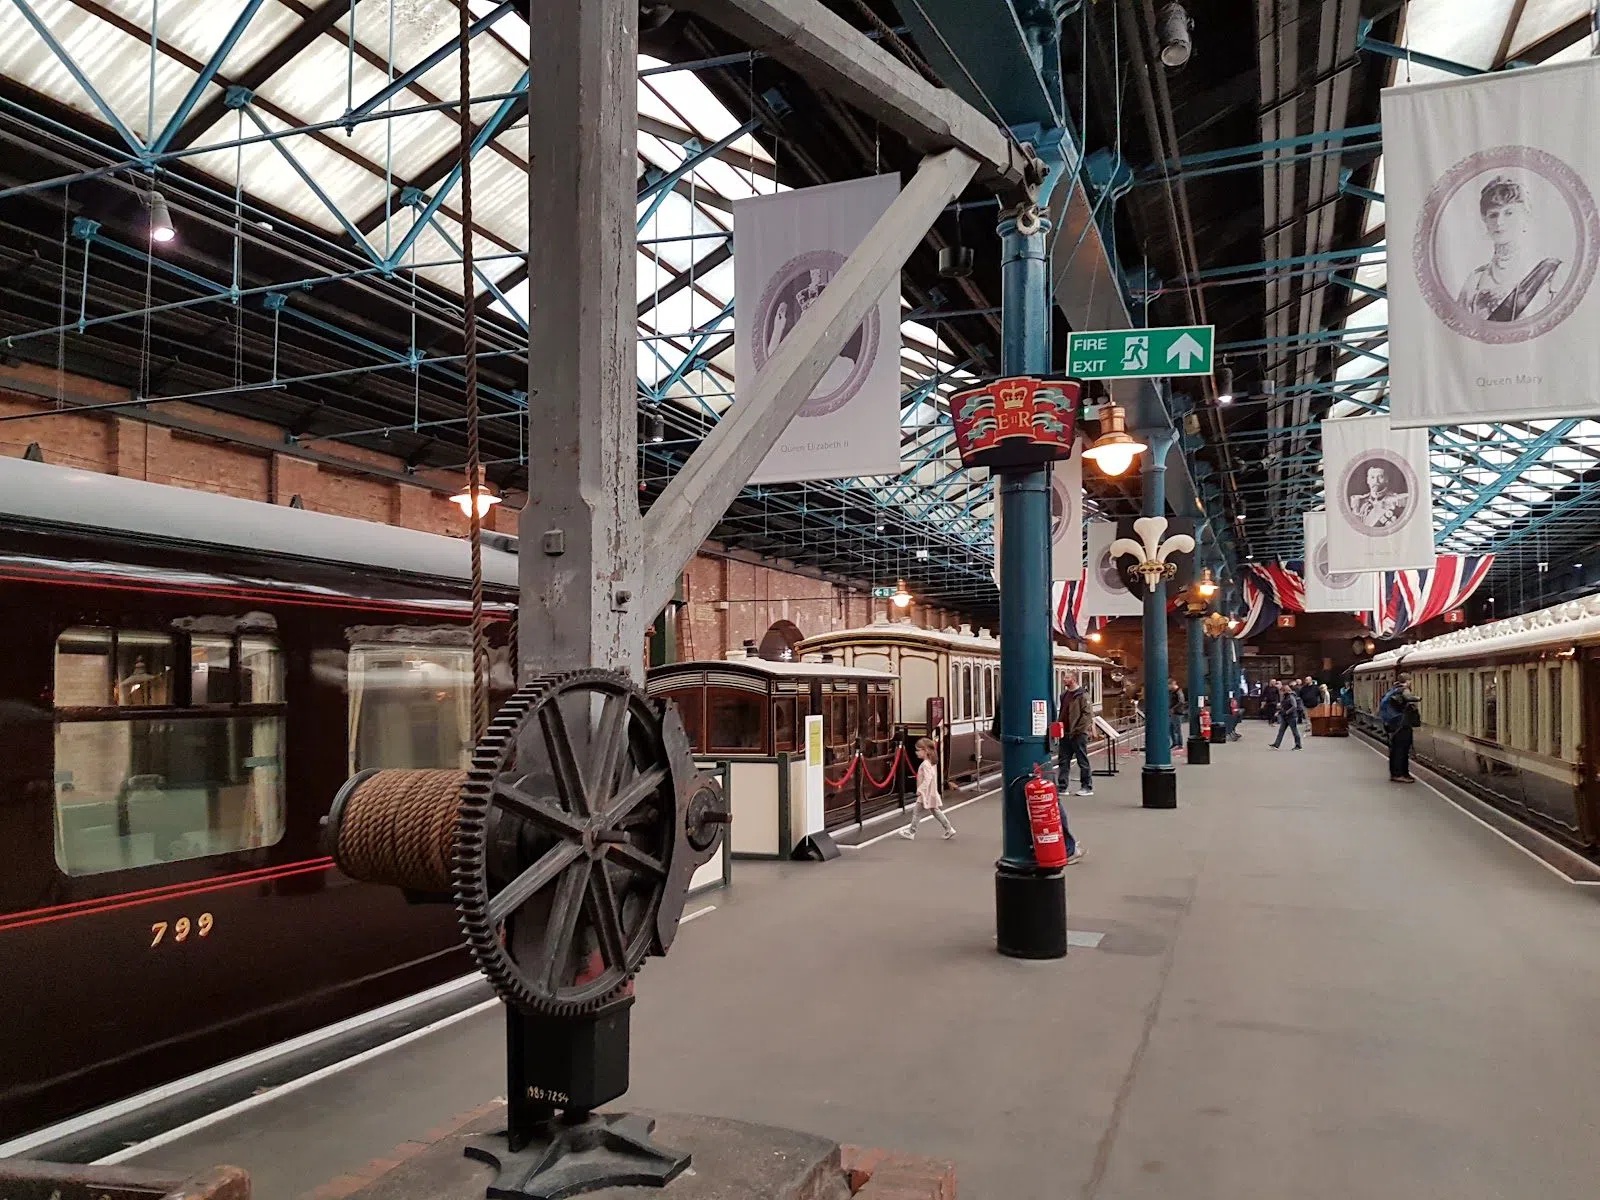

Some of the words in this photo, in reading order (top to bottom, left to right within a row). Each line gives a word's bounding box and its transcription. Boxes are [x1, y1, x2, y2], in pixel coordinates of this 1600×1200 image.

[1073, 338, 1108, 351] FIRE
[1072, 360, 1107, 373] EXIT
[1476, 376, 1513, 388] Queen
[1516, 374, 1544, 385] Mary
[807, 441, 841, 451] Elizabeth
[151, 912, 214, 947] 799
